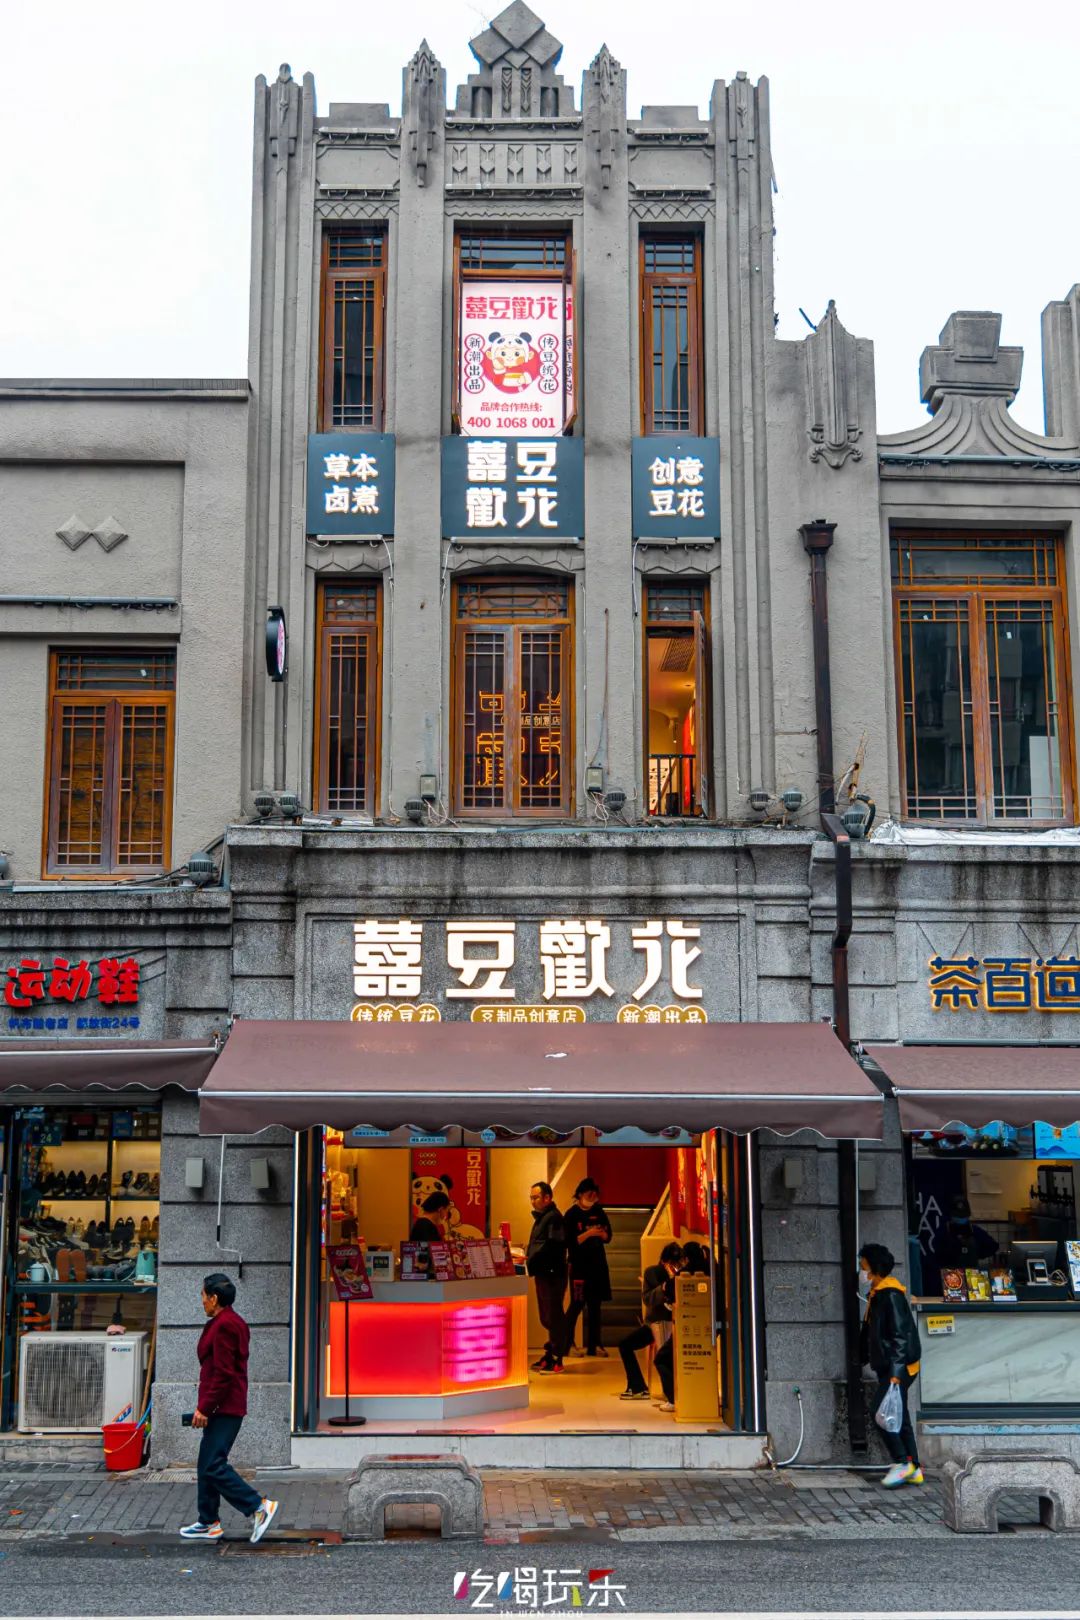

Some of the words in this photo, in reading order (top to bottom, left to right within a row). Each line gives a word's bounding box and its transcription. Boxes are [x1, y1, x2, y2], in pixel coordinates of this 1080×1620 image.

[468, 336, 481, 390] 新潮出品
[467, 417, 491, 428] 400
[496, 417, 527, 428] 1068
[532, 417, 555, 428] 001
[322, 452, 379, 482] 草本
[649, 456, 705, 487] 创意
[323, 485, 380, 515] 卤煮
[649, 488, 705, 518] 豆花
[4, 957, 140, 1009] 运动鞋
[929, 955, 1080, 1012] 茶百道
